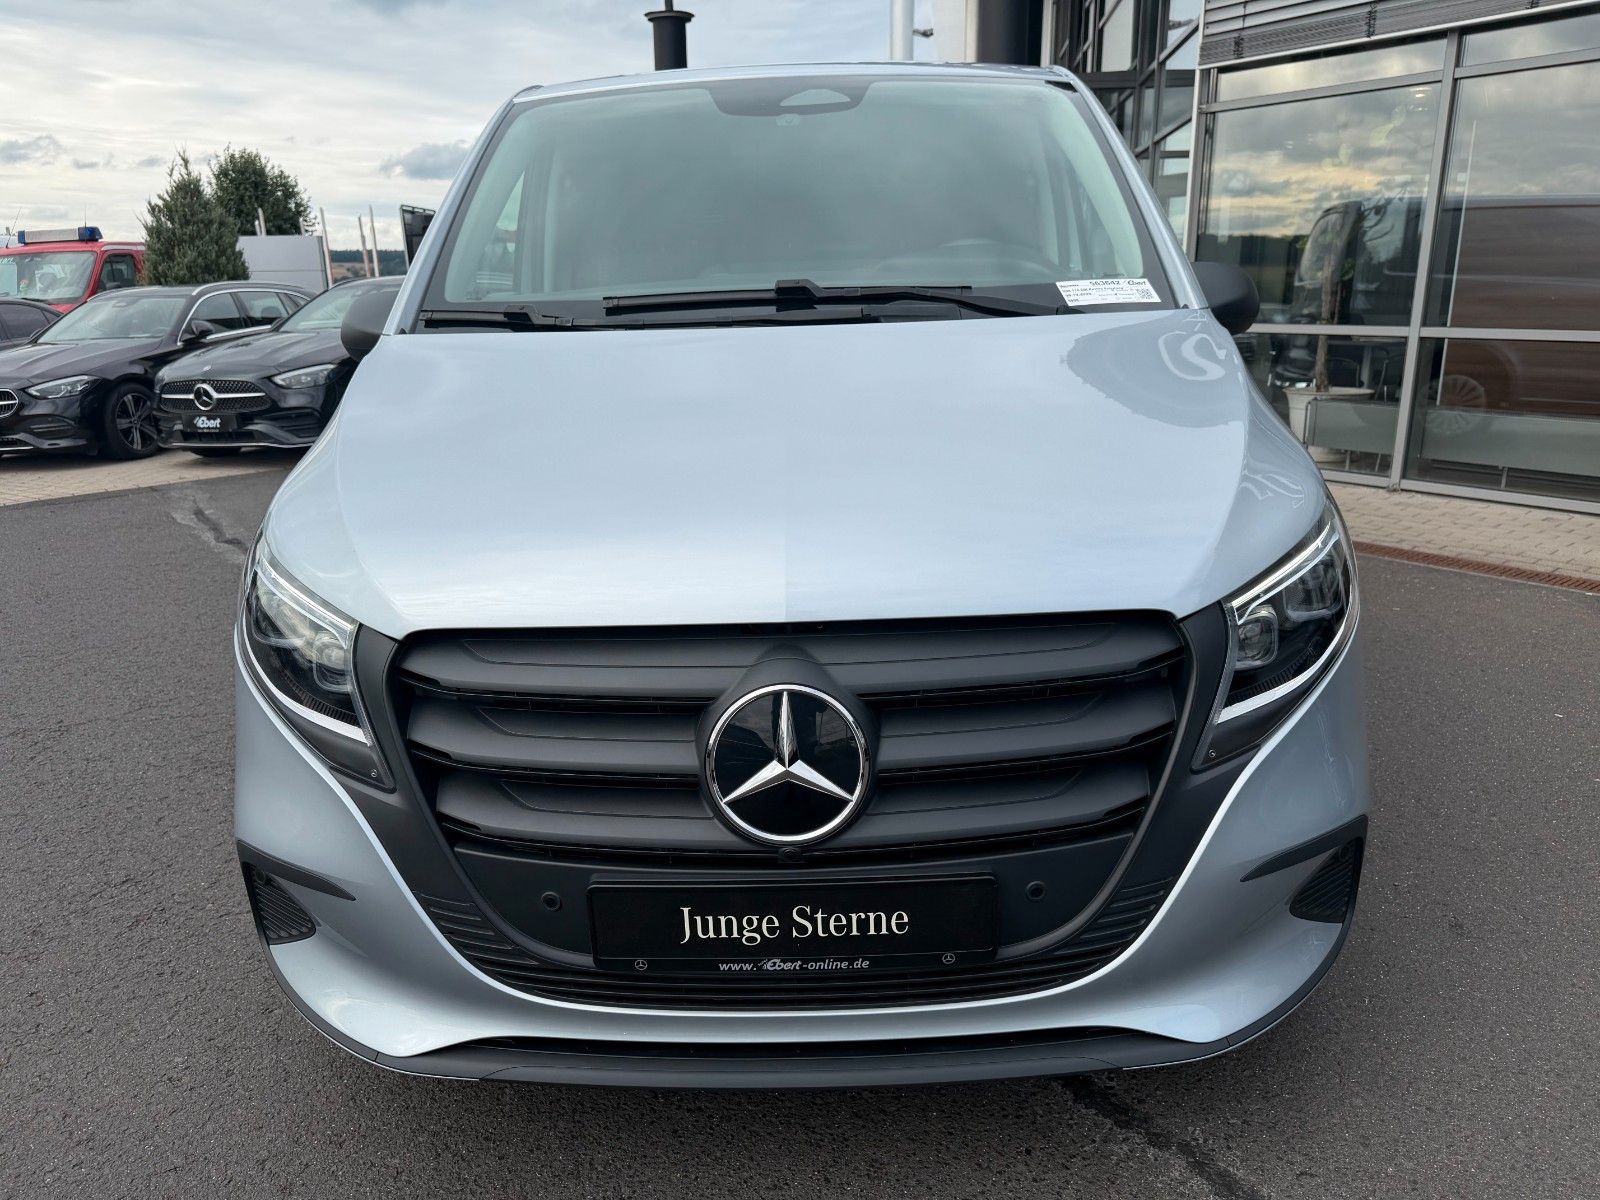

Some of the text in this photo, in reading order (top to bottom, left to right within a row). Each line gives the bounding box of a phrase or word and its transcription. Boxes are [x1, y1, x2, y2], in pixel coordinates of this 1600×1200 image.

[197, 416, 221, 428] Ebert
[680, 905, 909, 945] Junge Sterne
